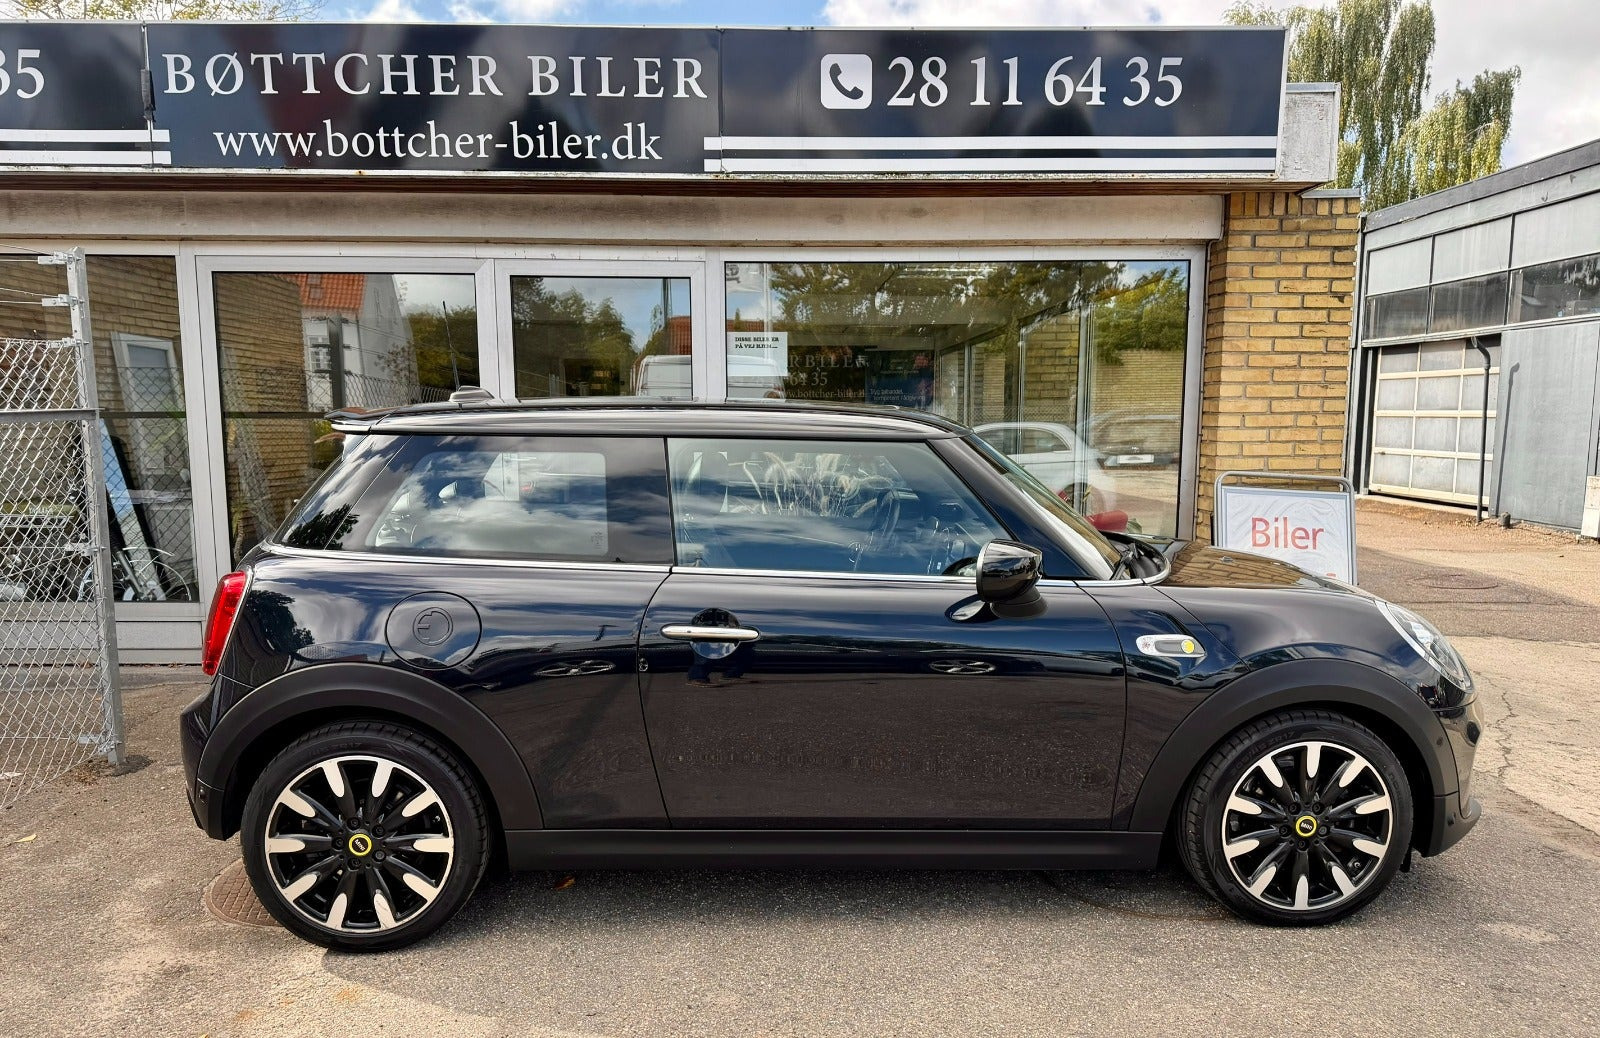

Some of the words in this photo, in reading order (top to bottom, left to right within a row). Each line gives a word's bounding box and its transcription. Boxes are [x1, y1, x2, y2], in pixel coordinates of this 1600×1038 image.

[162, 51, 504, 98] BØTTCHER
[527, 55, 708, 99] BILER
[886, 56, 949, 107] 28
[969, 56, 1022, 106] 11
[1044, 55, 1107, 106] 64
[1122, 56, 1183, 107] 35
[212, 118, 663, 162] www.bottcher-biler.dk
[811, 371, 828, 386] 35
[1251, 516, 1324, 550] Biler
